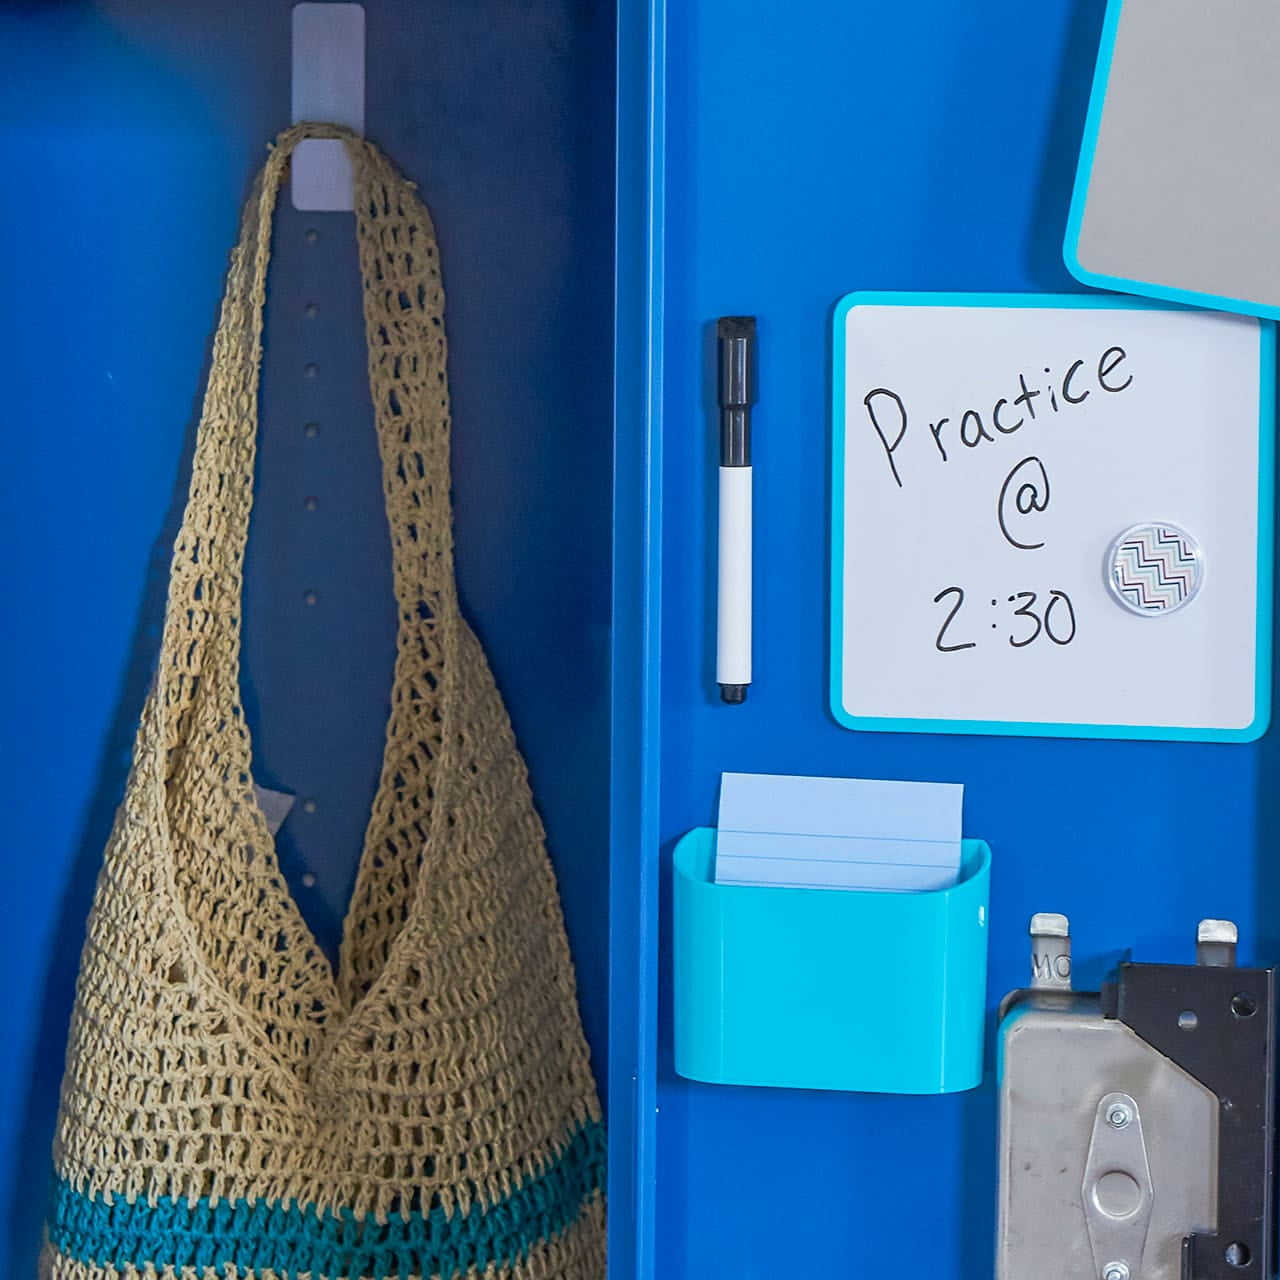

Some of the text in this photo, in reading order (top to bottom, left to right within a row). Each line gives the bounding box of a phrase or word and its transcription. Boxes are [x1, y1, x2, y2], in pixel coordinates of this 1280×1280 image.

[863, 345, 1133, 488] Practice
[997, 456, 1050, 550] @
[933, 586, 1077, 653] 2:30
